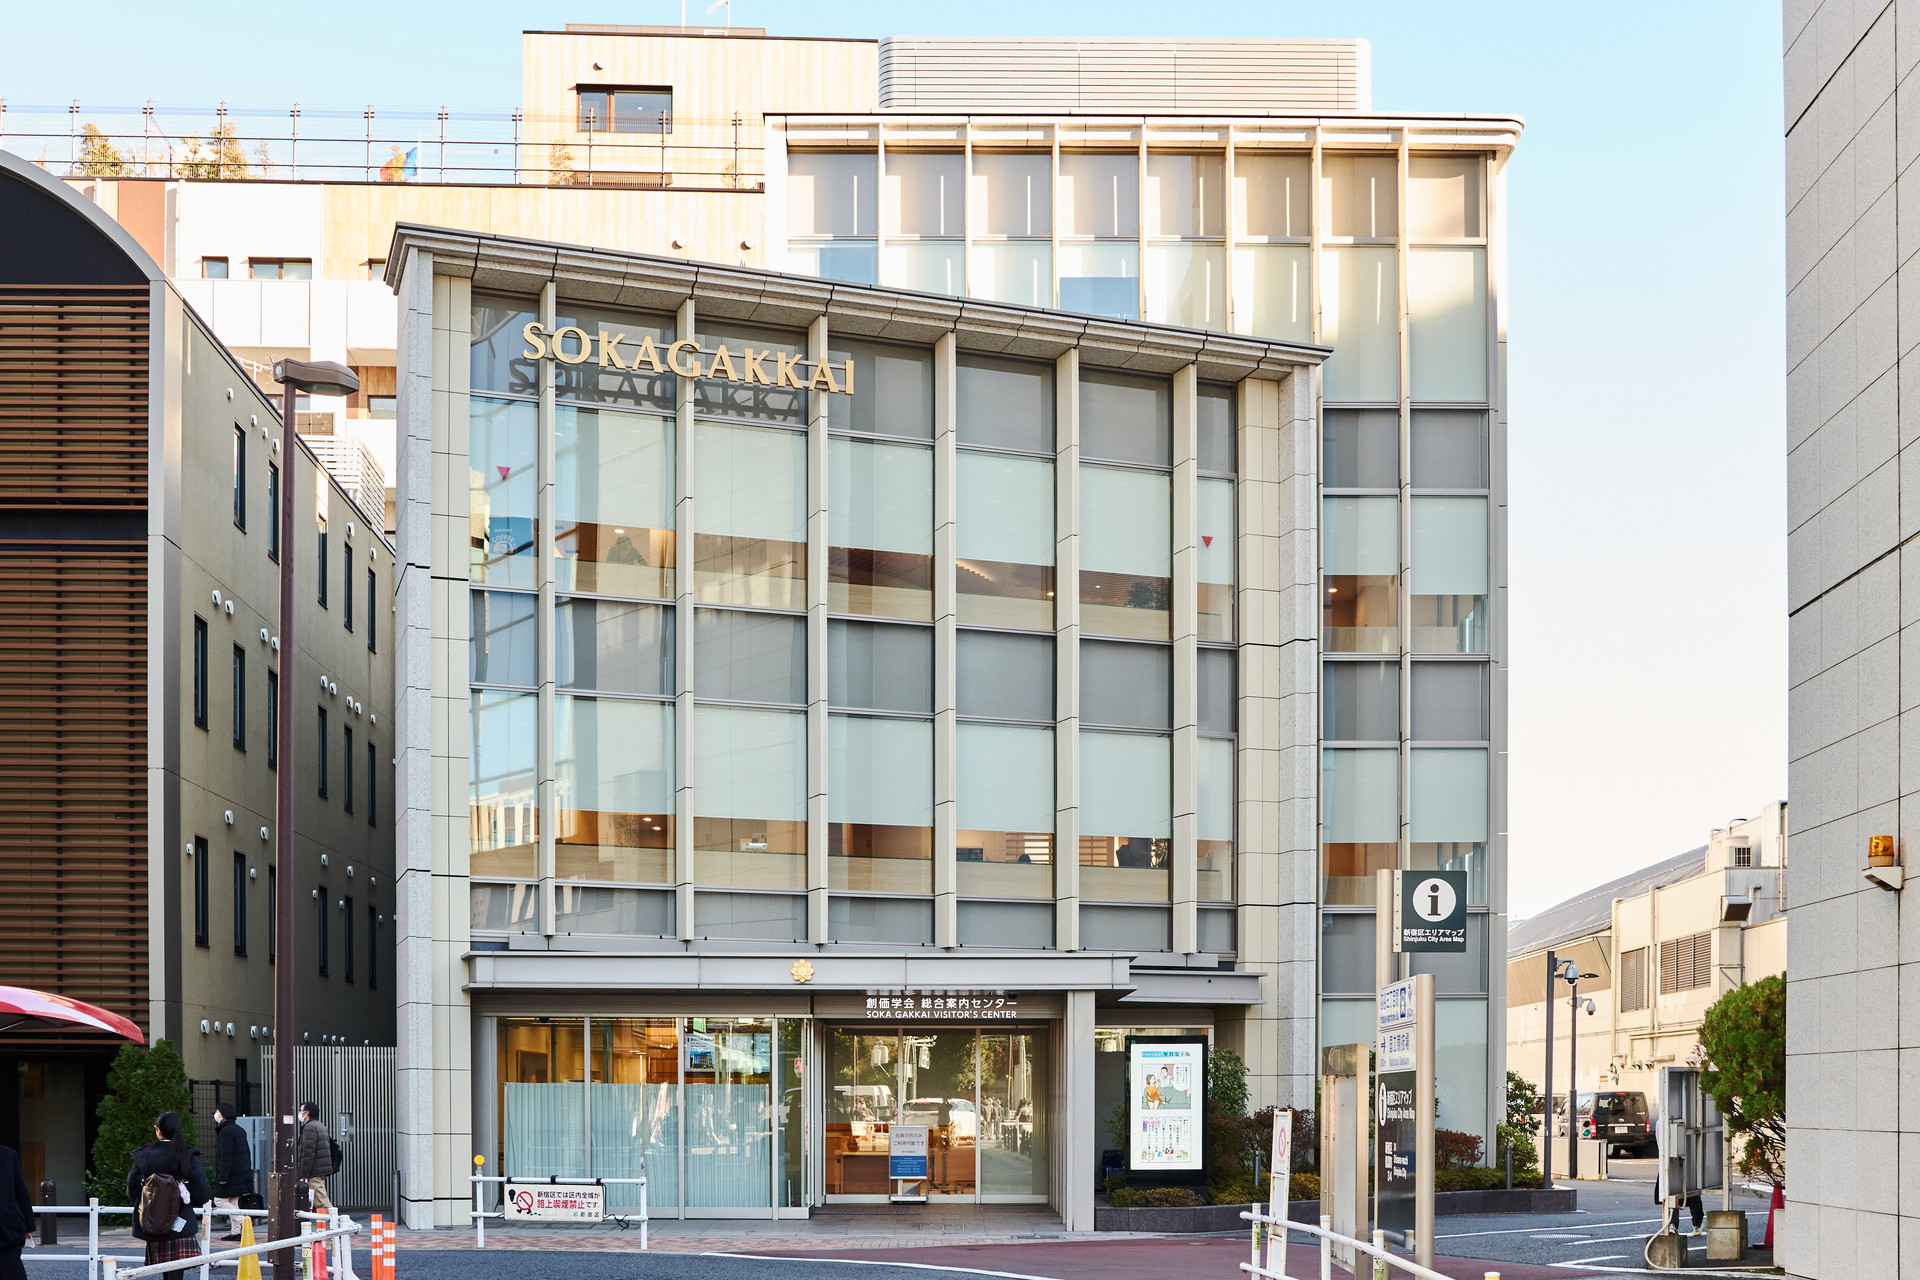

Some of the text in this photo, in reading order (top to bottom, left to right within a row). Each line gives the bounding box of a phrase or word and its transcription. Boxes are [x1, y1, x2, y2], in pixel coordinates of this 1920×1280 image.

[523, 321, 855, 395] SOKAGAKKAI
[491, 534, 516, 543] COFFEE
[1403, 928, 1465, 936] 新宿区エリアマップ
[866, 997, 1017, 1009] 創価学会 総合案内センター
[866, 1010, 1017, 1019] SOKA GAKKAI VISITOR'S CENTER
